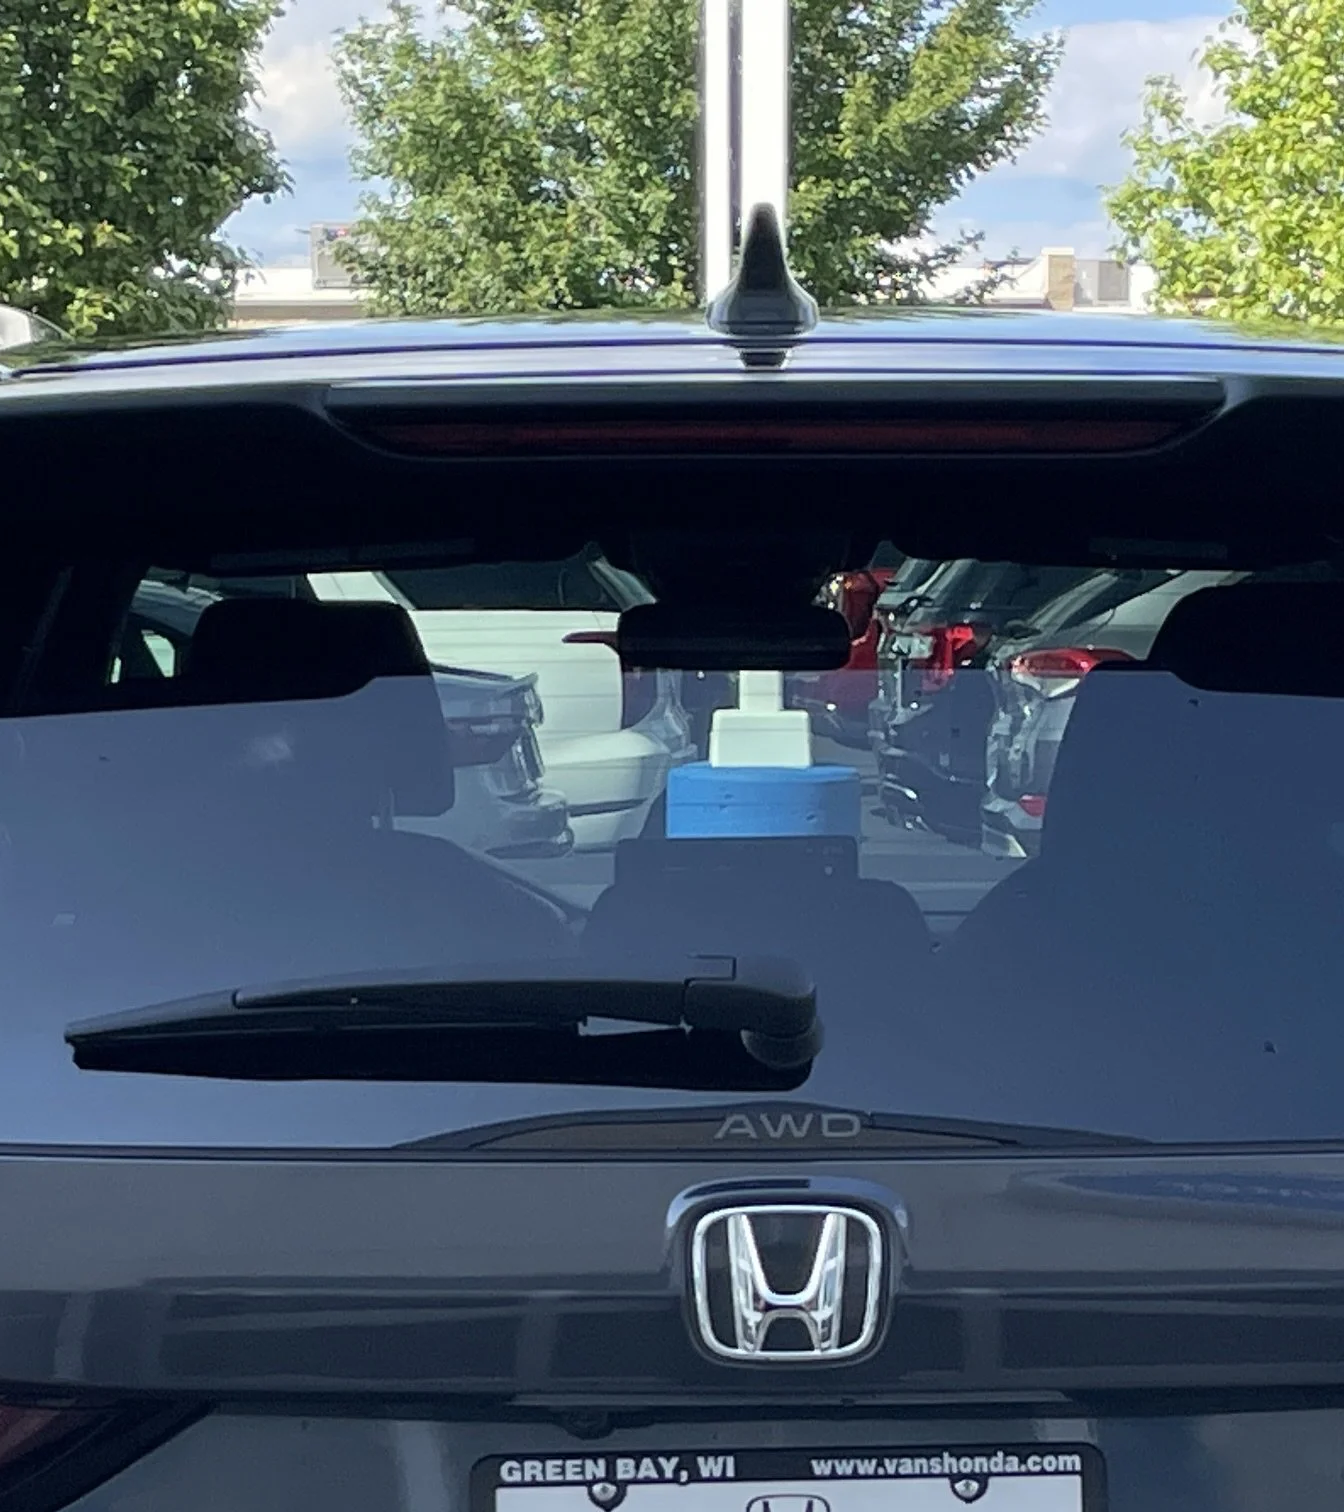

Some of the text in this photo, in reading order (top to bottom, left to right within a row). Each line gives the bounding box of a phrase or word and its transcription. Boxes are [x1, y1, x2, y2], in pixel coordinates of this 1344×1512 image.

[714, 1112, 862, 1139] AWD
[500, 1456, 736, 1483] GREEN BAY, WI
[810, 1451, 1082, 1477] www.vanshonda.com
